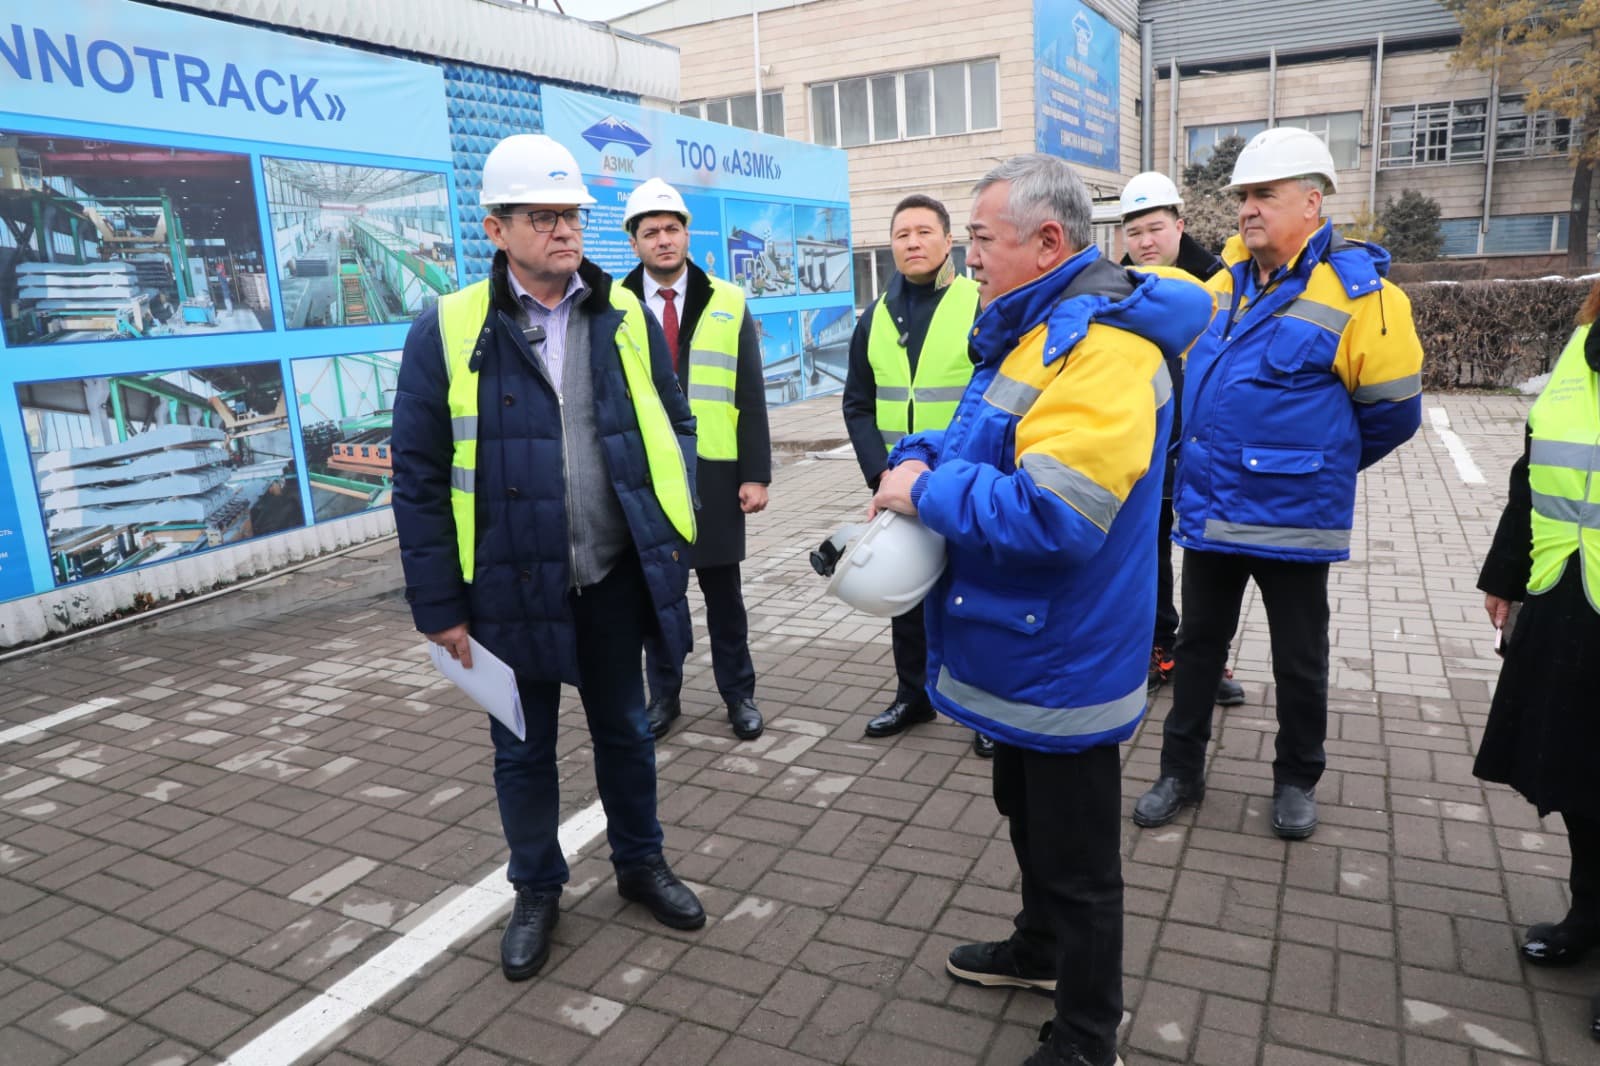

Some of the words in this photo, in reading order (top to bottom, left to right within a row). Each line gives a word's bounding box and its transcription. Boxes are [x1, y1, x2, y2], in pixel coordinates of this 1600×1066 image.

[603, 155, 635, 173] АЗМК
[676, 139, 717, 172] ТОО
[722, 148, 782, 180] «АЗМК»
